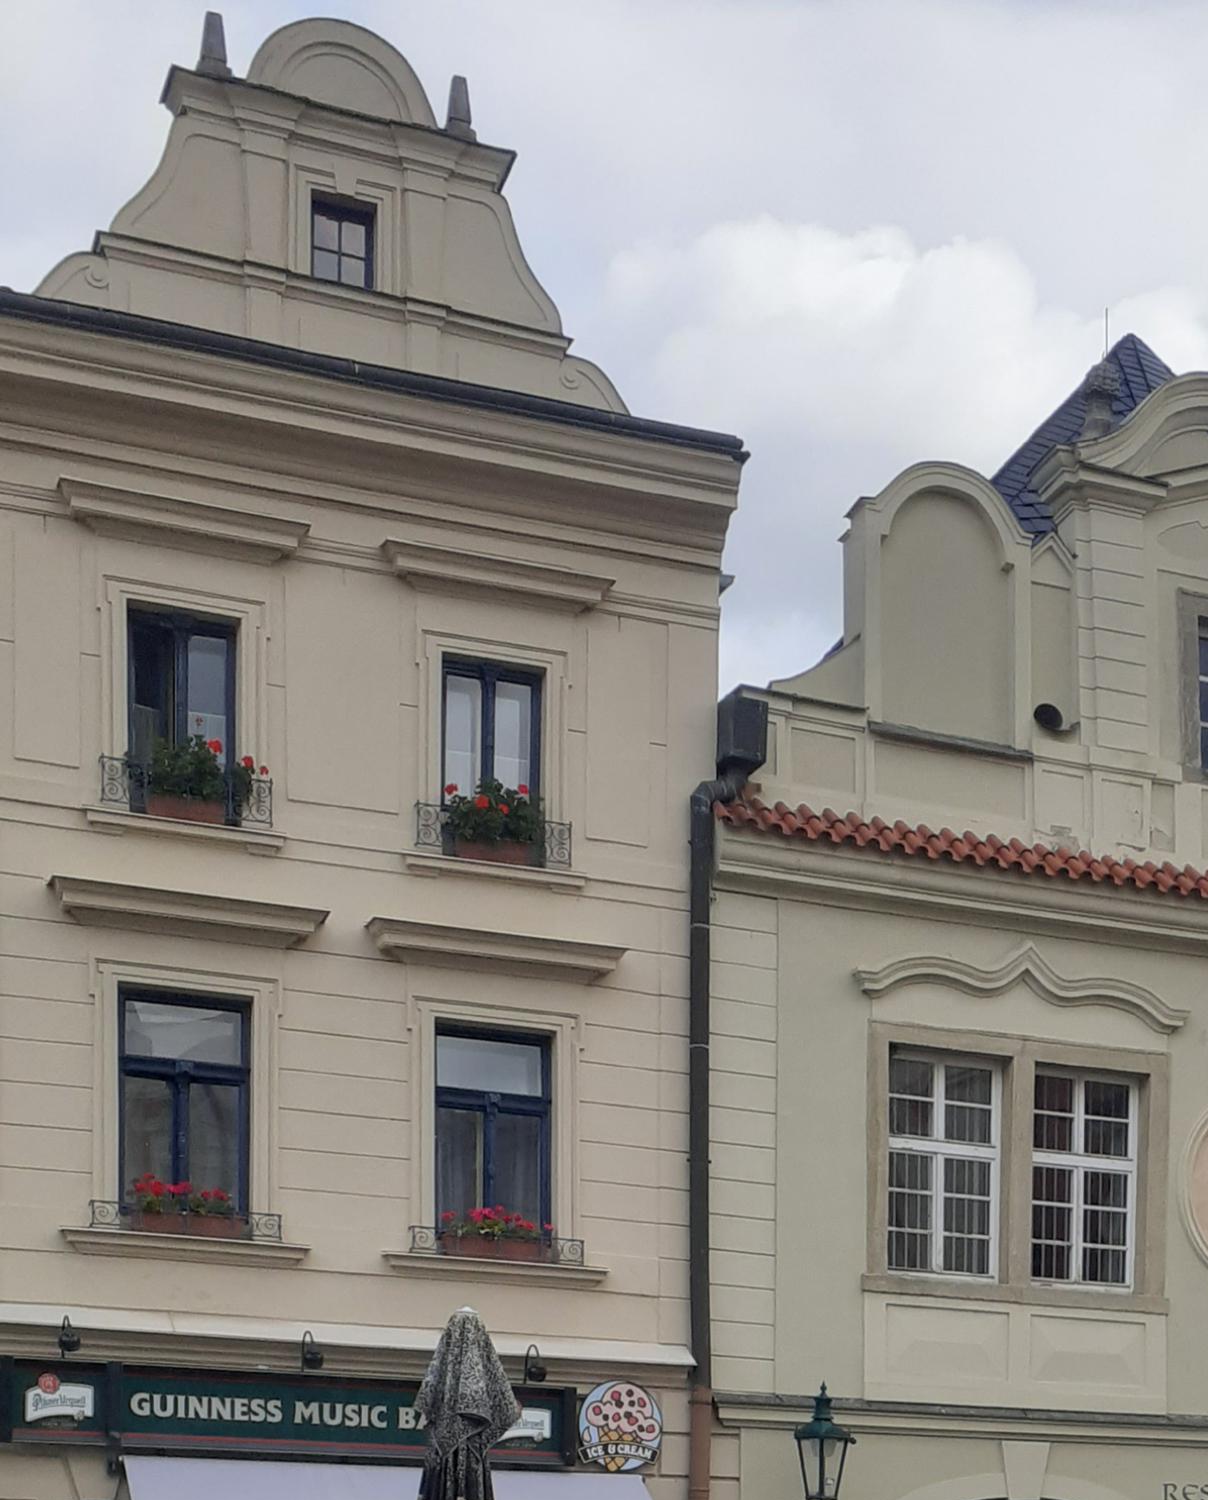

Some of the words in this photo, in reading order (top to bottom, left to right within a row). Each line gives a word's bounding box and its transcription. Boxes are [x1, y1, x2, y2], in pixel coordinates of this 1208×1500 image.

[130, 1392, 283, 1423] GUINNESS
[293, 1401, 388, 1429] MUSIC
[586, 1445, 605, 1458] ICE
[616, 1444, 653, 1459] CREAM
